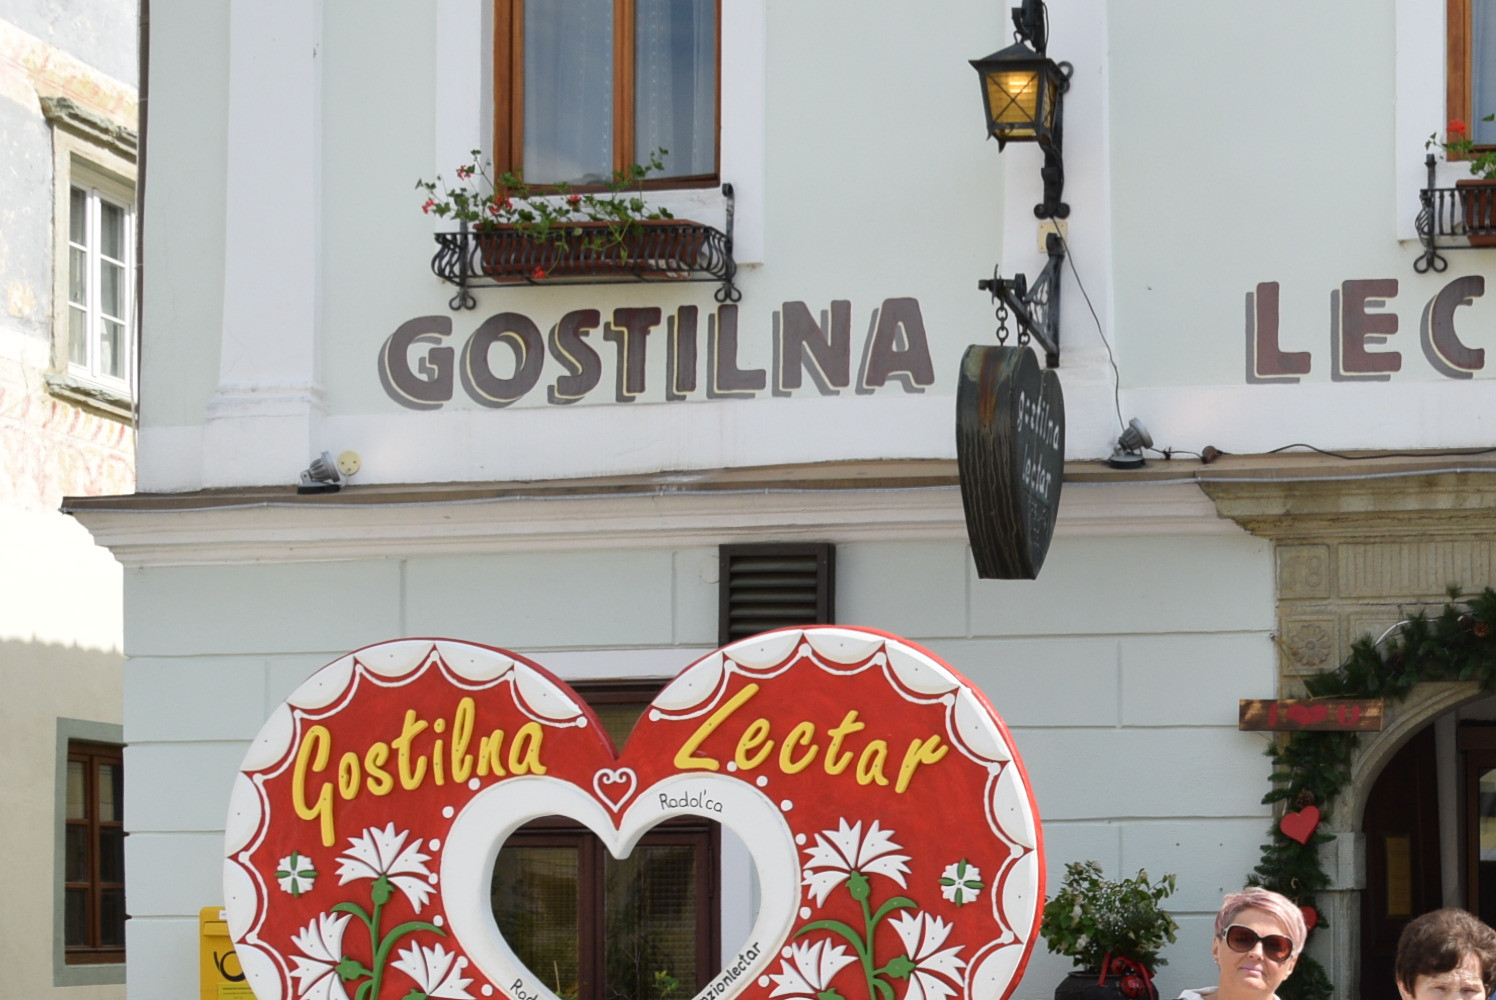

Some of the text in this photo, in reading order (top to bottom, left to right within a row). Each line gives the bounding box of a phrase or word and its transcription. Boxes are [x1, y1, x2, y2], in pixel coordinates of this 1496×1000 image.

[378, 297, 935, 410] GOSTILNA
[1017, 391, 1060, 450] gostilna
[1022, 443, 1052, 499] lectar
[673, 683, 949, 793] Lectar
[1337, 704, 1361, 727] U
[291, 697, 548, 846] Gostilna
[658, 789, 723, 813] Radol'ca
